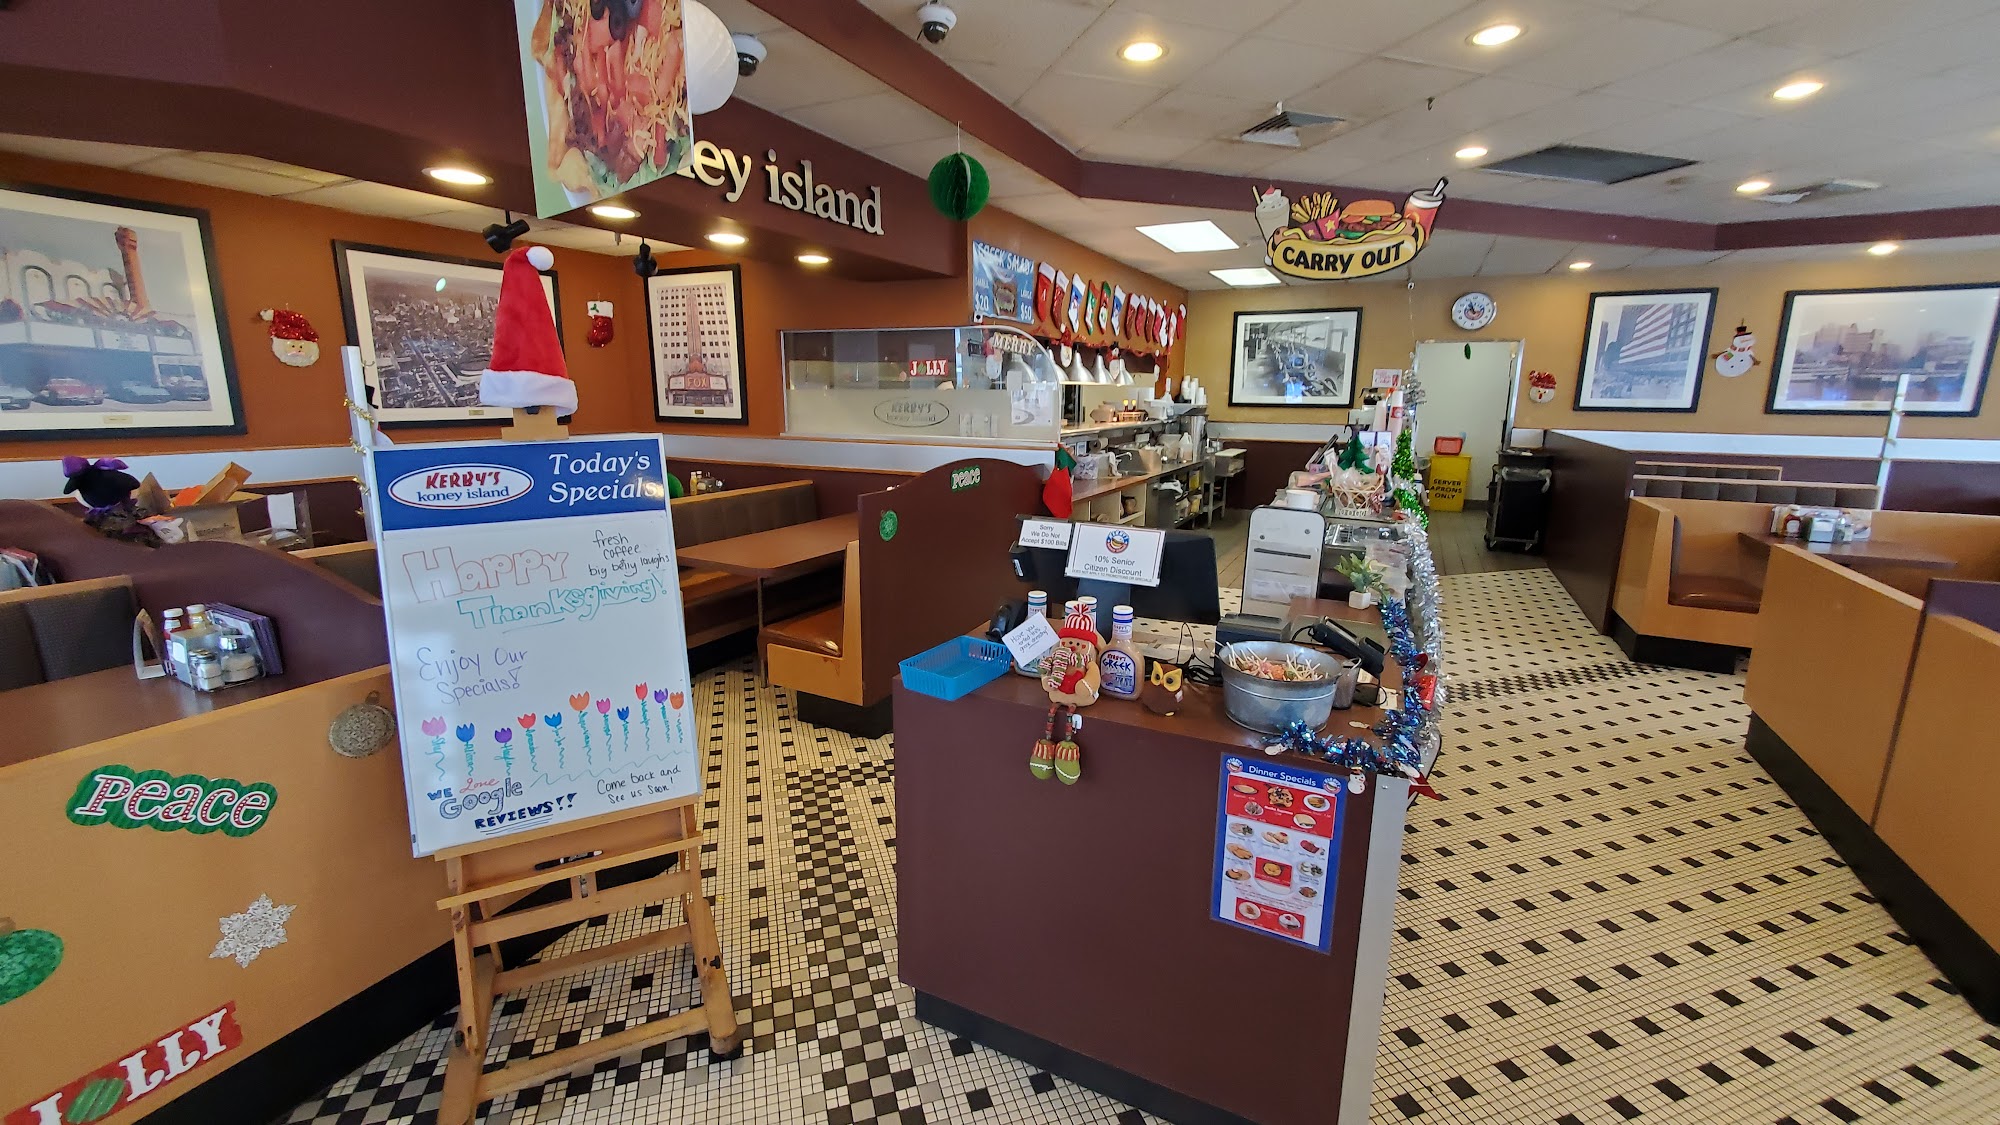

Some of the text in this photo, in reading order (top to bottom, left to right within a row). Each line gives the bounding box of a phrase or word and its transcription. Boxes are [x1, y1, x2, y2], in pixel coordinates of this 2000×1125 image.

[765, 148, 885, 236] island
[1282, 240, 1406, 275] CARRY OUT
[974, 291, 990, 312] $20
[1020, 302, 1032, 321] $50
[687, 377, 708, 388] FOX
[548, 450, 651, 476] Today's
[425, 471, 501, 490] KERBY'S
[951, 467, 981, 490] Peace
[1433, 478, 1462, 486] SERVER
[417, 485, 510, 503] koney island
[548, 476, 659, 506] Specials
[1430, 485, 1463, 494] APRONS
[1434, 492, 1456, 500] ONLY
[1039, 524, 1055, 532] Sorry
[592, 529, 629, 548] fresh
[1021, 536, 1040, 545] Accept
[603, 544, 641, 560] coffee
[1094, 555, 1136, 567] 10% Senior
[588, 563, 608, 579] big
[639, 553, 670, 570] laughs
[1083, 563, 1142, 577] Citizen Discount
[416, 646, 529, 685] Enjoy Our
[1102, 657, 1132, 672] GREEK
[596, 764, 682, 795] Come back and
[1248, 764, 1279, 779] Dinner
[1279, 771, 1317, 788] Specials
[74, 773, 273, 829] Peace
[426, 787, 454, 801] WE
[439, 776, 524, 820] Google
[630, 789, 643, 798] us
